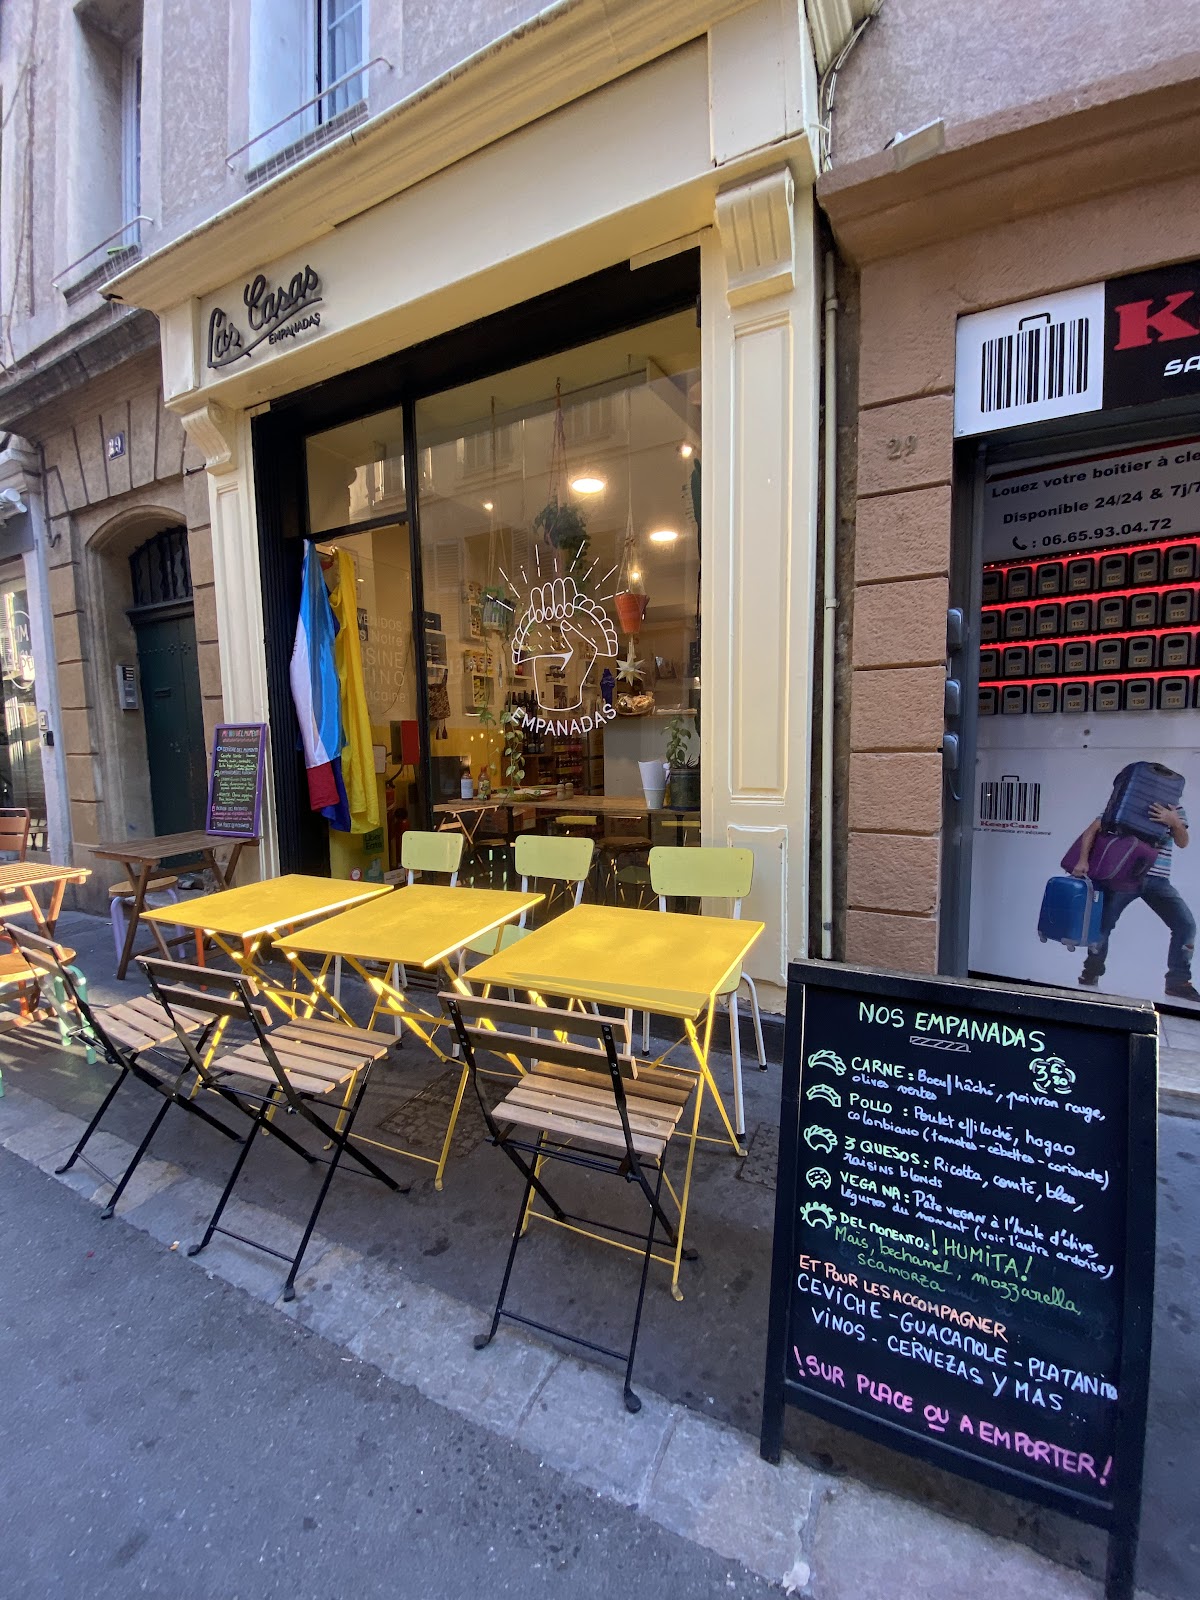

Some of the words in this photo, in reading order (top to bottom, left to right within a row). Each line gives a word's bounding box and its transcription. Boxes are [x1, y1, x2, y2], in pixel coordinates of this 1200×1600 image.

[207, 307, 242, 369] Las
[243, 264, 320, 331] Casas
[268, 312, 321, 345] EMPANADAS
[1114, 290, 1200, 351] K
[992, 481, 1039, 498] Louez
[1043, 471, 1087, 488] votre
[1092, 460, 1152, 479] boîtier
[1157, 455, 1169, 468] à
[1003, 501, 1089, 525] Disponible
[1094, 490, 1143, 509] 24/24
[1149, 488, 1163, 500] &
[1041, 517, 1172, 547] 06.65.93.04.72
[1174, 566, 1188, 574] 107
[1072, 620, 1084, 628] 112
[1103, 658, 1116, 666] 121
[1134, 655, 1148, 664] 122
[1169, 653, 1183, 662] 123
[511, 703, 617, 737] EMPANADAS
[1038, 701, 1050, 709] 127
[980, 820, 1039, 829] KeepCase
[859, 1001, 905, 1028] NOS
[914, 1011, 1046, 1053] EMPANADAS
[851, 1073, 889, 1089] olives
[1006, 1091, 1059, 1111] poivron
[1064, 1102, 1106, 1124] rouge,
[914, 1105, 955, 1129] Poulet
[1025, 1128, 1076, 1157] hogao
[844, 1135, 857, 1151] 3
[933, 1155, 989, 1189] Ricotta,
[899, 1165, 943, 1189] blonds
[840, 1211, 868, 1230] DEL
[990, 1214, 1000, 1229] à
[892, 1202, 910, 1216] du
[914, 1211, 970, 1234] moment
[974, 1224, 1006, 1244] (voir
[1008, 1234, 1050, 1258] l'autre
[1056, 1251, 1114, 1280] ardoise)
[799, 1254, 822, 1272] ET
[824, 1262, 859, 1289] POUR
[863, 1279, 891, 1299] LES
[797, 1272, 882, 1320] CEVICHE
[900, 1311, 1008, 1367] GUACAMOLE
[811, 1305, 866, 1342] VINOS
[887, 1334, 984, 1386] CERVEZAS
[991, 1371, 1008, 1397] Y
[856, 1373, 914, 1413] PLACE
[923, 1404, 950, 1425] OU
[959, 1414, 974, 1436] A
